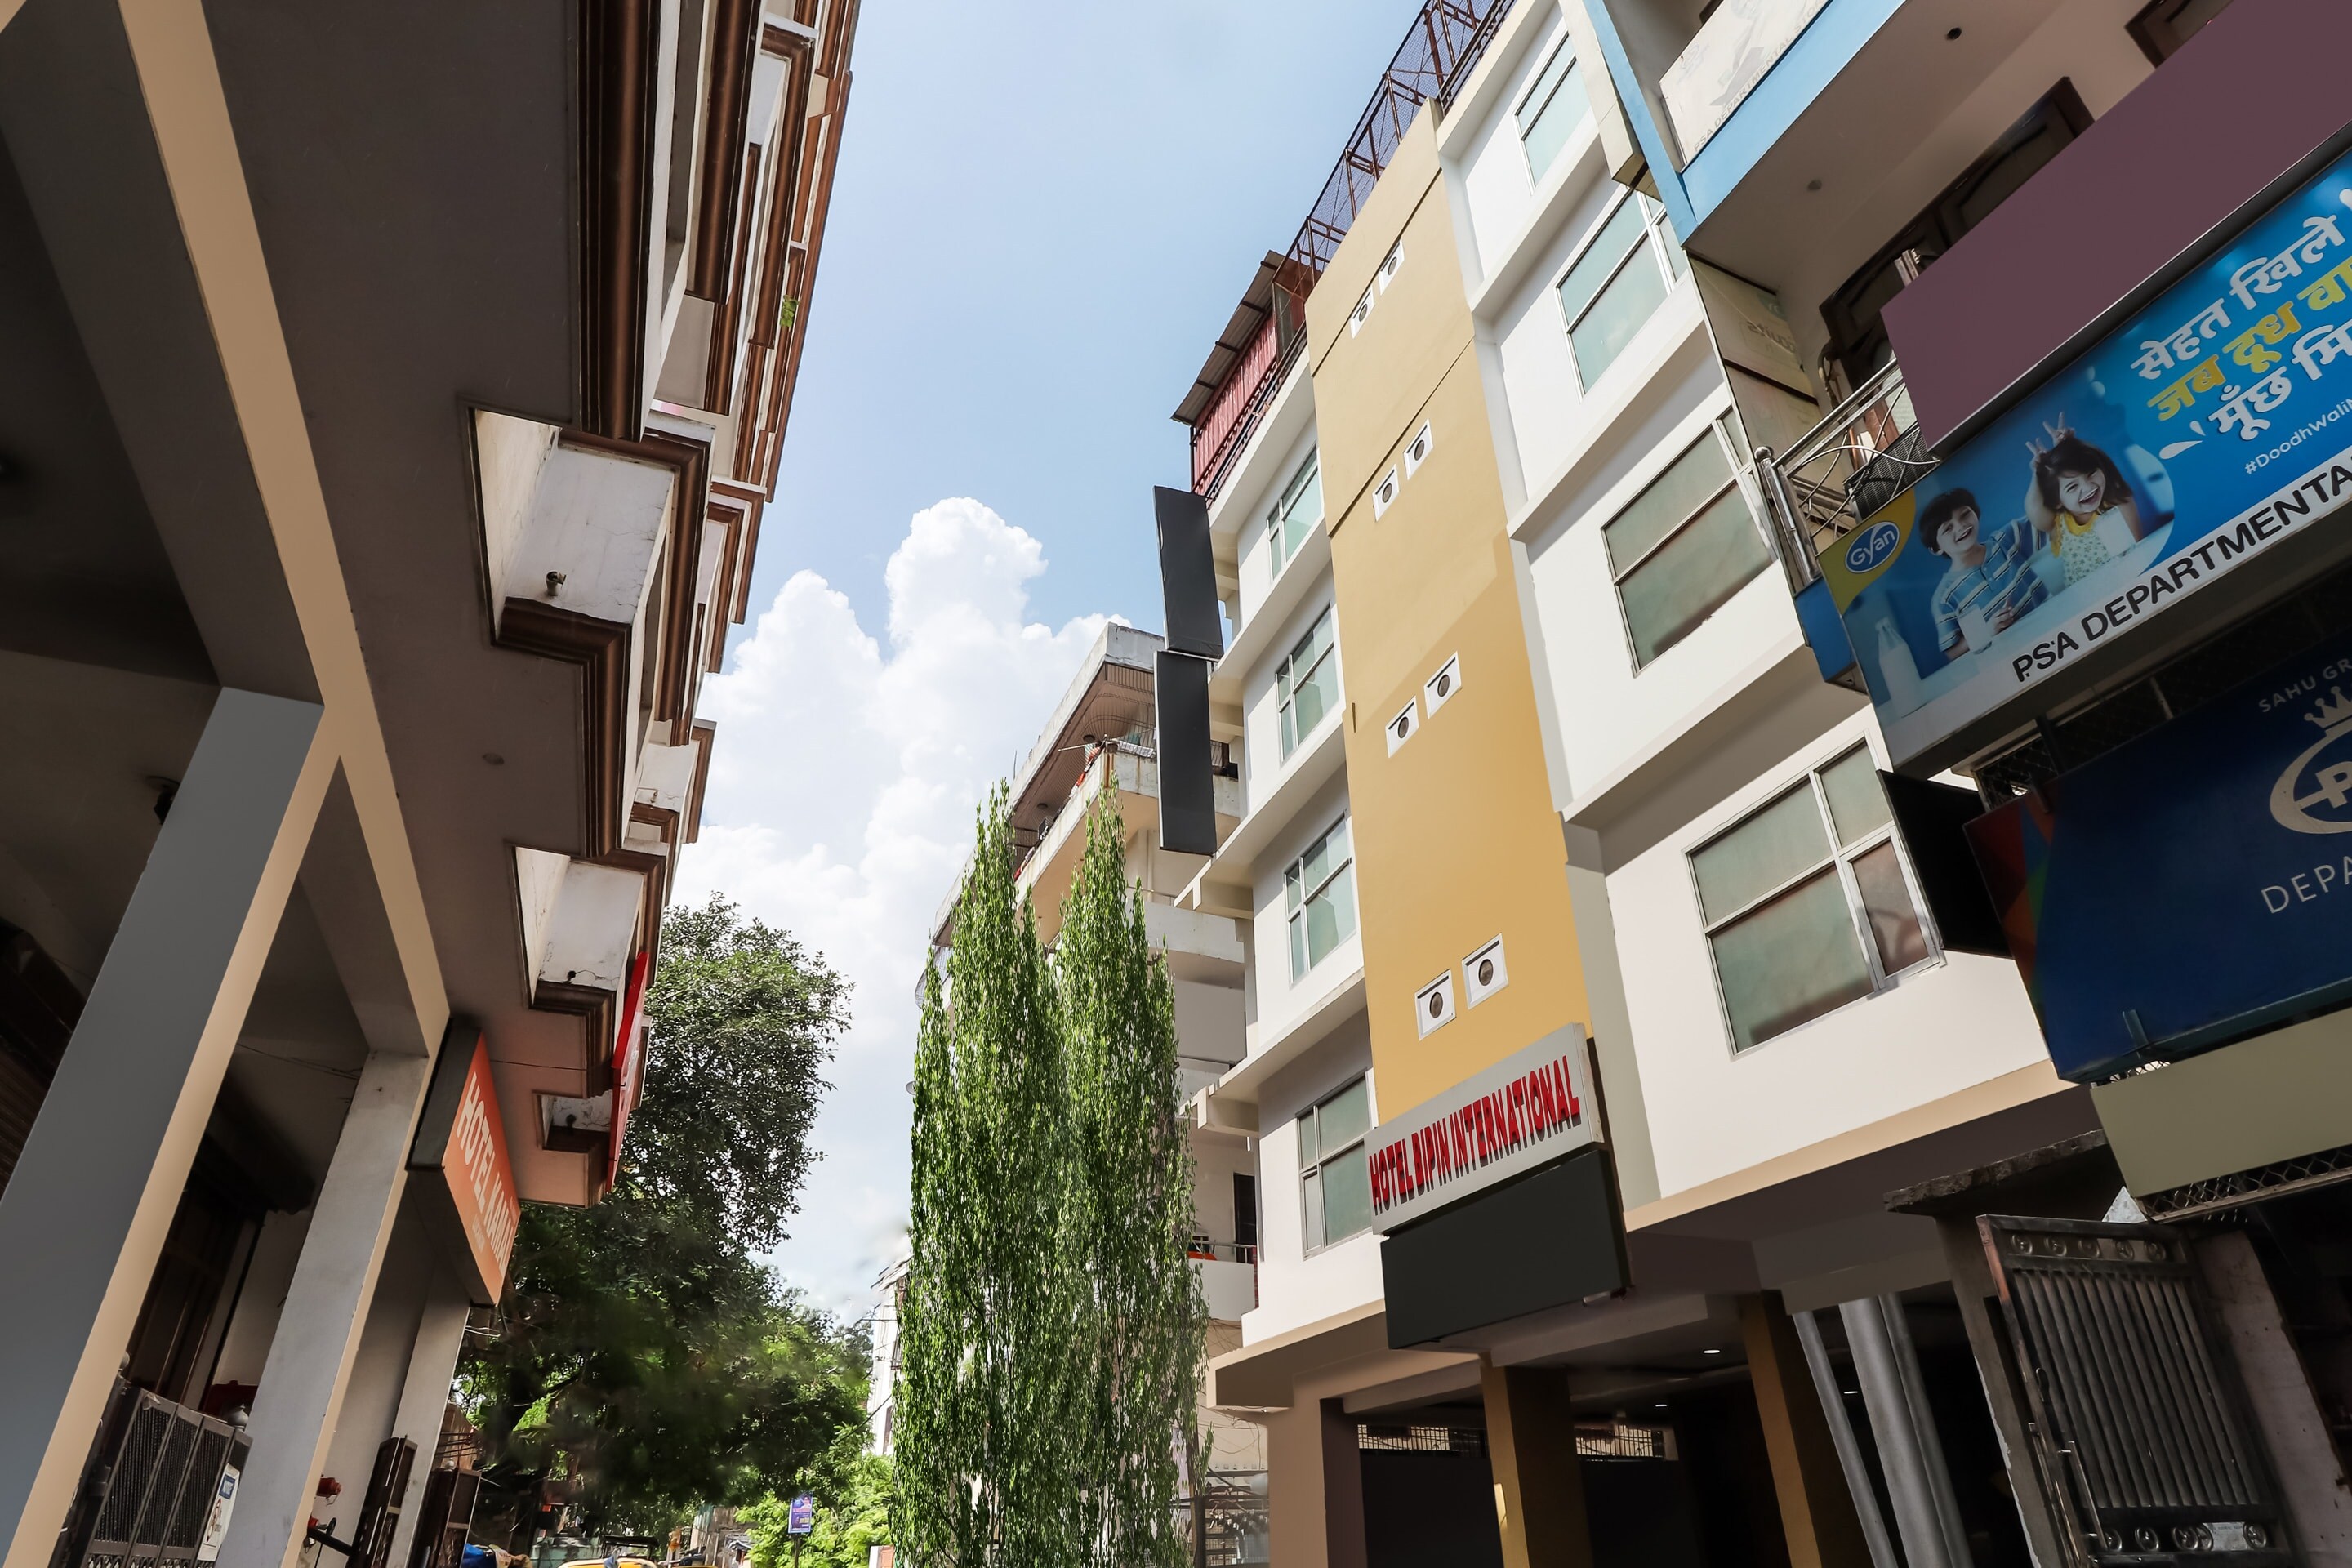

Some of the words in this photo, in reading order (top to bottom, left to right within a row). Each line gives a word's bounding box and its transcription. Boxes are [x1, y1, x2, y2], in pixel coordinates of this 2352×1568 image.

[1694, 128, 1713, 152] PSA
[1714, 36, 1793, 129] DEPARTMENTAL
[2131, 298, 2232, 379] सेहत
[2230, 215, 2346, 310] खिले
[2147, 354, 2226, 421] जब
[2222, 301, 2302, 374] दूध
[1850, 521, 1895, 566] Gyan
[2011, 631, 2079, 683] PSA
[2081, 453, 2352, 642] DEPARTMENTA
[2258, 675, 2317, 713] SAHU
[456, 1071, 496, 1214] HOTEL
[485, 1171, 512, 1278] KAMAL
[1369, 1138, 1413, 1207] HOTEL
[1411, 1117, 1451, 1187] BIPIN
[1449, 1055, 1580, 1169] INTERNATIONAL
